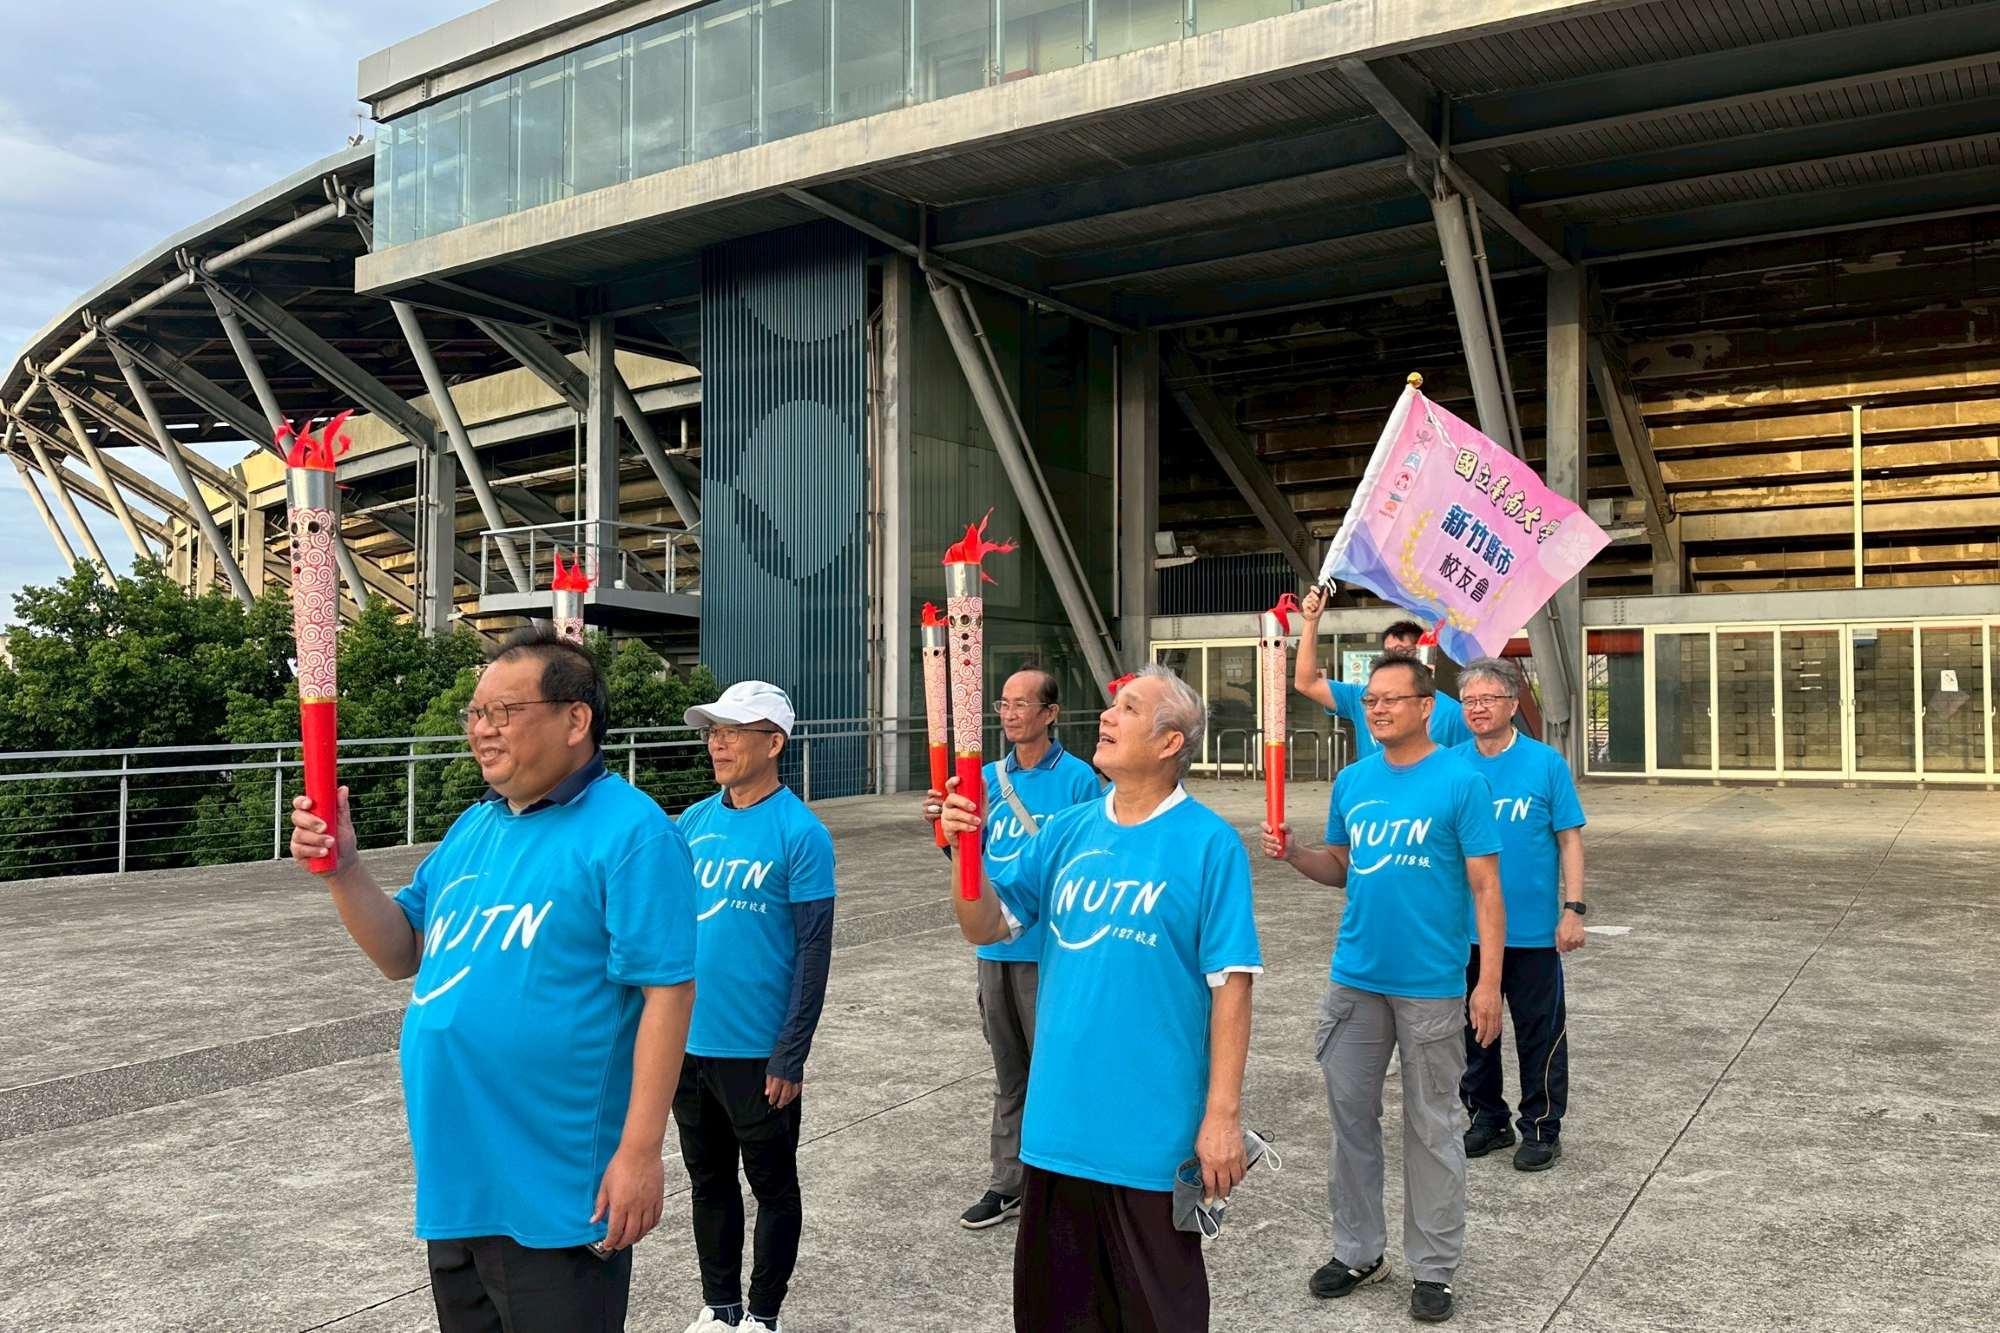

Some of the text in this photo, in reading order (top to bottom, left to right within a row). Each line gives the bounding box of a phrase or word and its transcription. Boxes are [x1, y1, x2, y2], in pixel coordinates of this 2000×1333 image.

[1440, 503, 1516, 576] 新竹縣市
[1438, 552, 1491, 603] 校友會
[1493, 796, 1532, 822] TN
[1350, 817, 1432, 850] NUTN
[1056, 876, 1168, 915] NUTN
